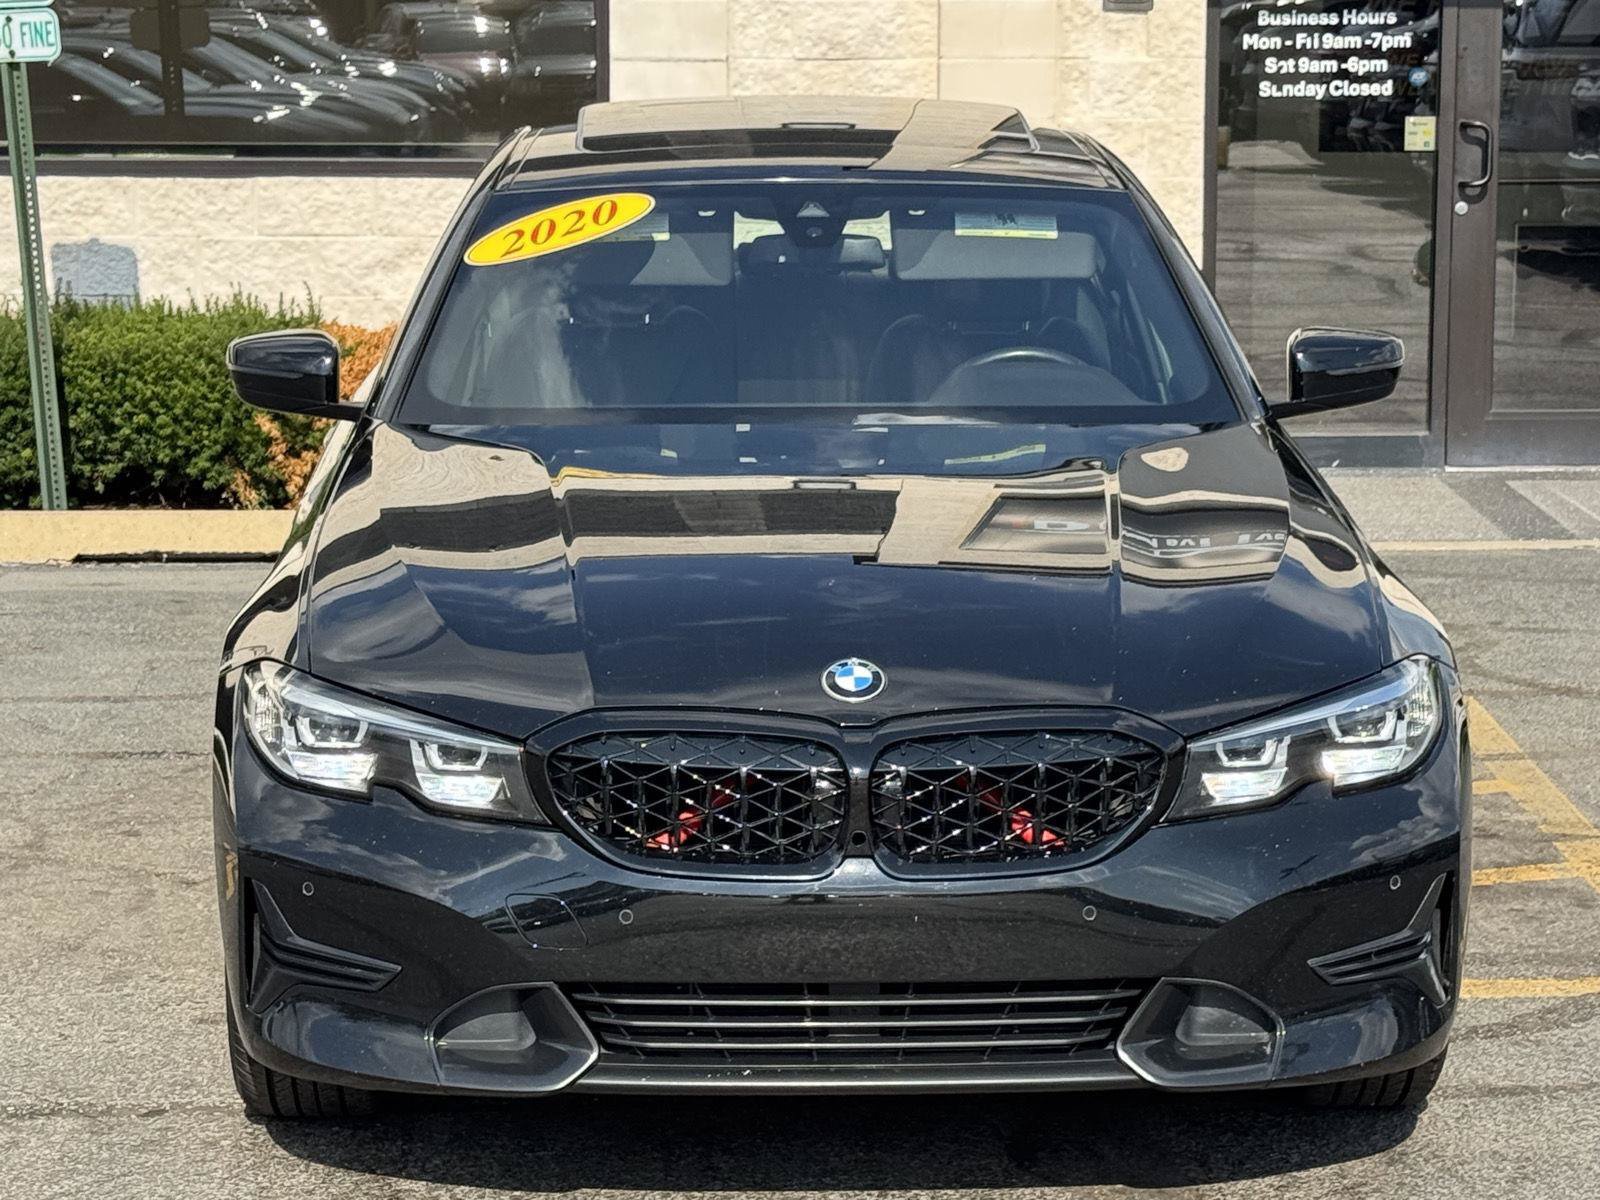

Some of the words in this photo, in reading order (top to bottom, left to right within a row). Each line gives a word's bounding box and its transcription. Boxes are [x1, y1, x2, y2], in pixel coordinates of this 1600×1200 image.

[1257, 10, 1339, 26] Business
[1342, 9, 1398, 25] Hours
[20, 21, 55, 48] FINE
[1242, 34, 1282, 50] Mon
[1322, 34, 1362, 49] 9am
[1298, 57, 1338, 73] 9am
[1329, 79, 1394, 97] Closed
[501, 199, 618, 258] 2020
